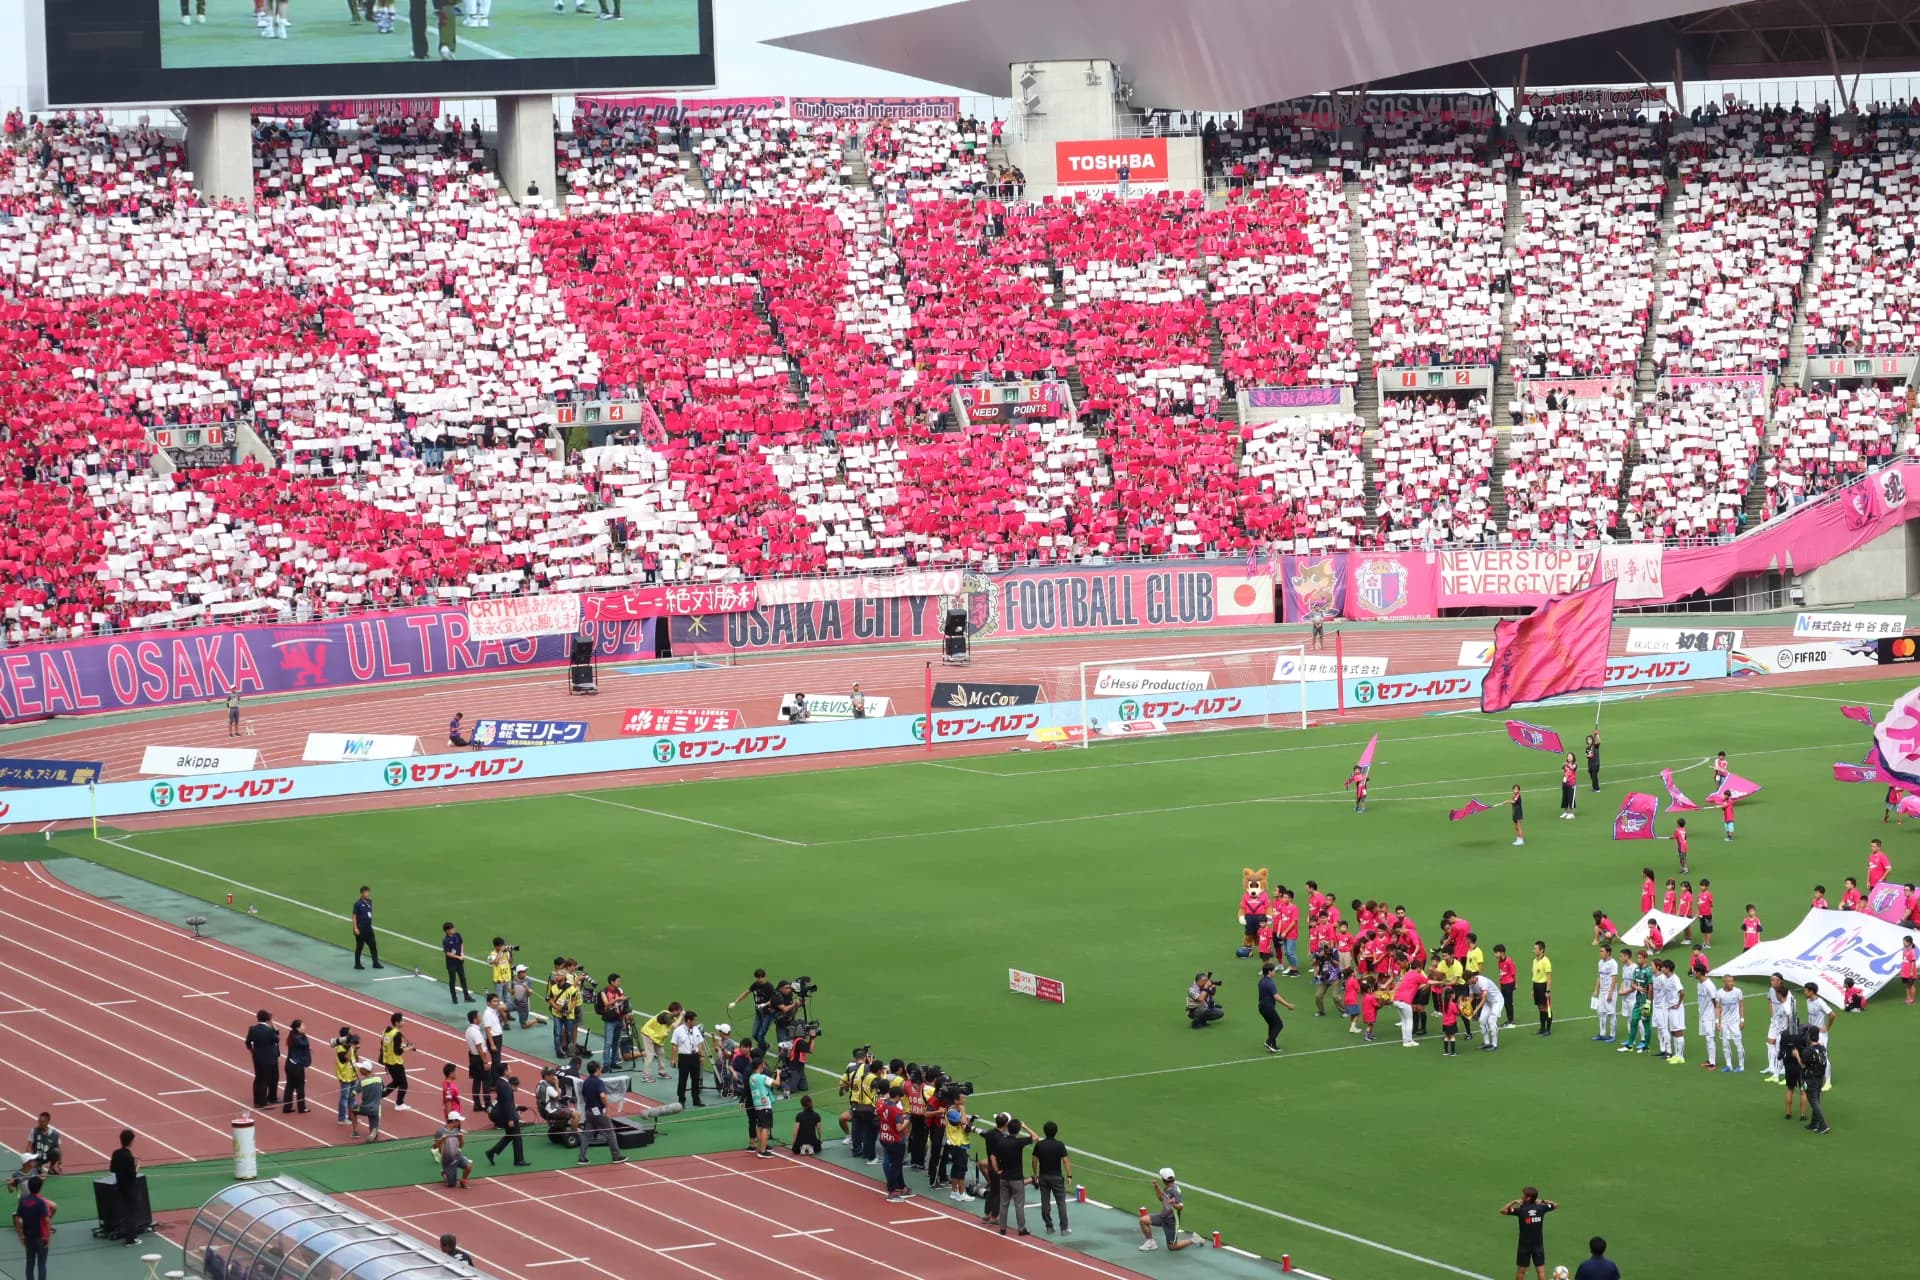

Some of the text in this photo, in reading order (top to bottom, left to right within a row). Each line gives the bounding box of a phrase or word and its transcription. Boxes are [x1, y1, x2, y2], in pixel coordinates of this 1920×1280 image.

[795, 102, 954, 119] Club Osaka Internacional
[1068, 153, 1155, 171] TOSHIBA
[1458, 372, 1467, 384] 2
[1032, 388, 1040, 399] 3
[612, 406, 621, 419] 4
[972, 404, 1047, 417] NEED POINTS
[1441, 550, 1572, 572] NEVER STOP
[762, 573, 961, 603] WE ARE CEREZO
[1442, 573, 1512, 595] NEVER
[1514, 573, 1567, 594] GIVE
[1005, 571, 1214, 633] FOOTBALL CLUB
[727, 594, 928, 649] OSAKA CITY
[108, 632, 264, 705] OSAKA
[344, 612, 538, 681] ULTRAS
[1141, 679, 1204, 691] Production
[515, 723, 582, 740] モリトク
[672, 716, 730, 733] ミツキ
[177, 756, 220, 769] akippa
